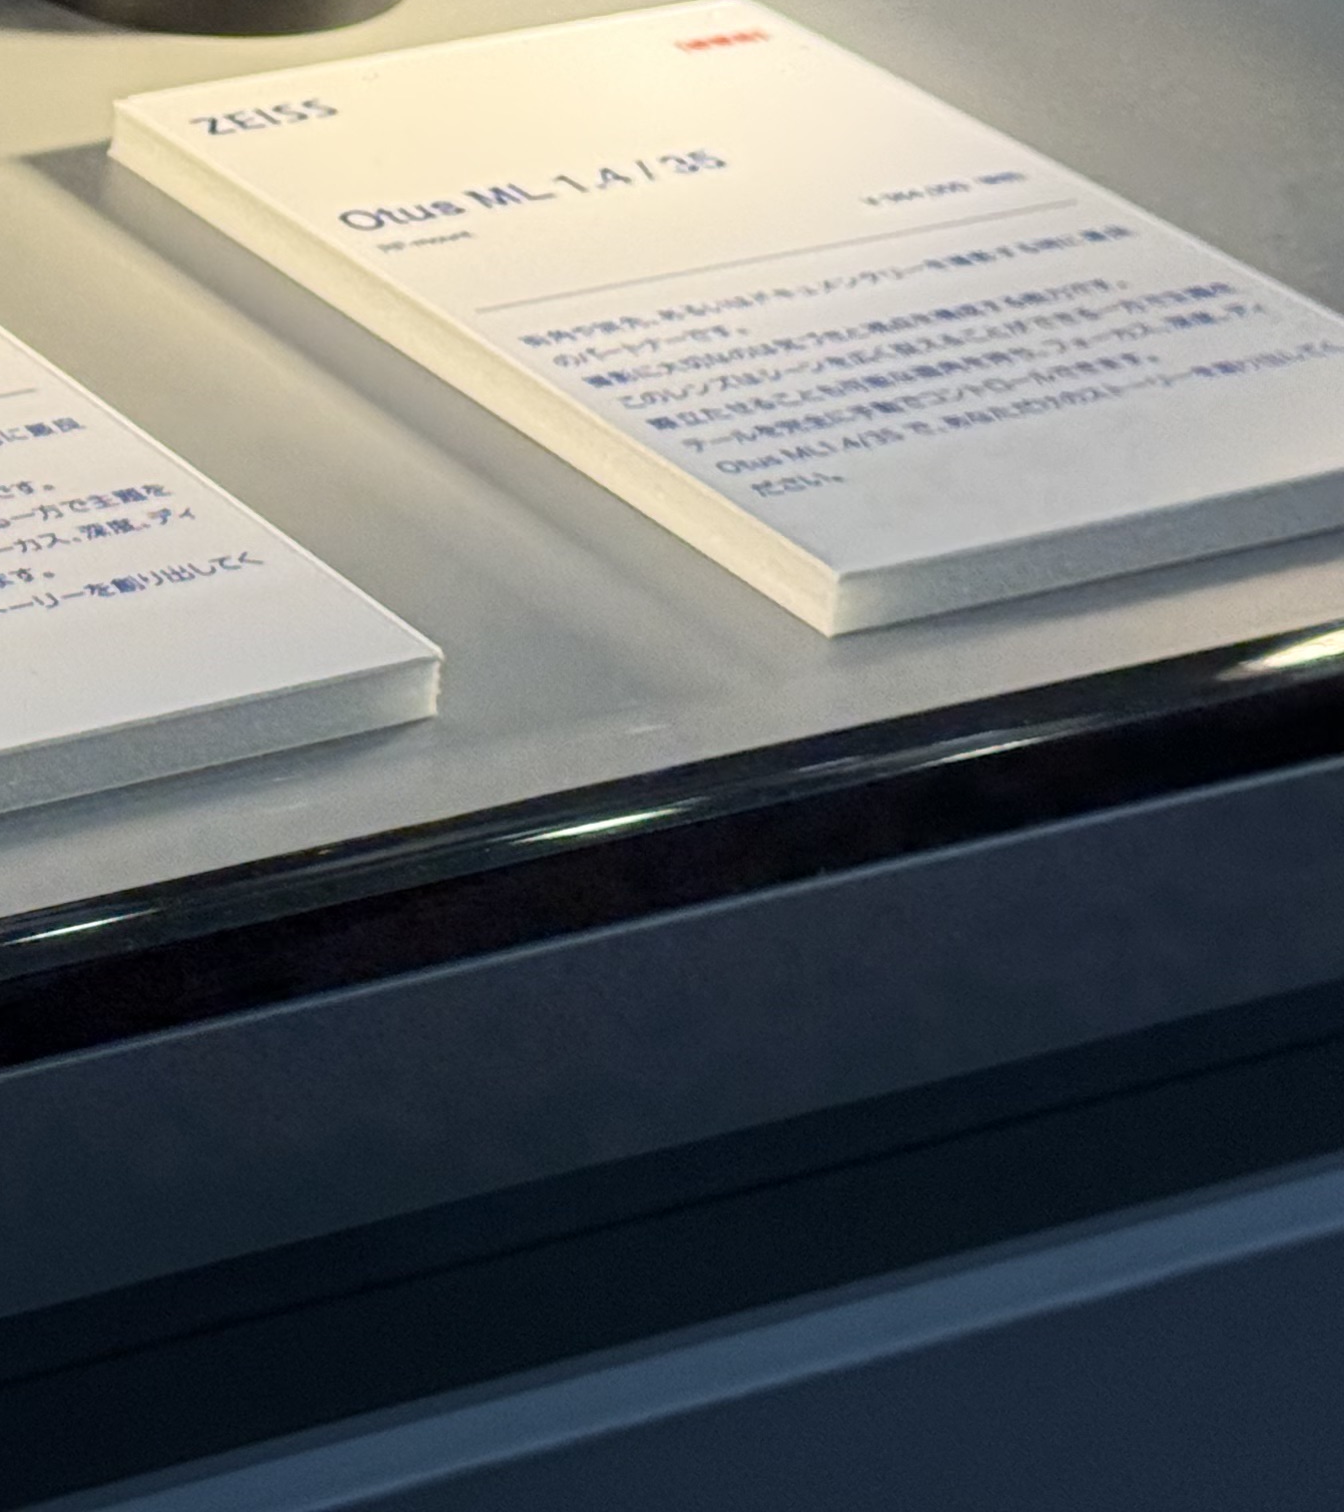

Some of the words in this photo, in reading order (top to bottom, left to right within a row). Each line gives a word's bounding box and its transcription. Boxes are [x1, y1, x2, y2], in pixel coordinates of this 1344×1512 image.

[188, 97, 340, 136] ZEISS
[338, 198, 466, 232] Otus
[467, 183, 556, 210] ML
